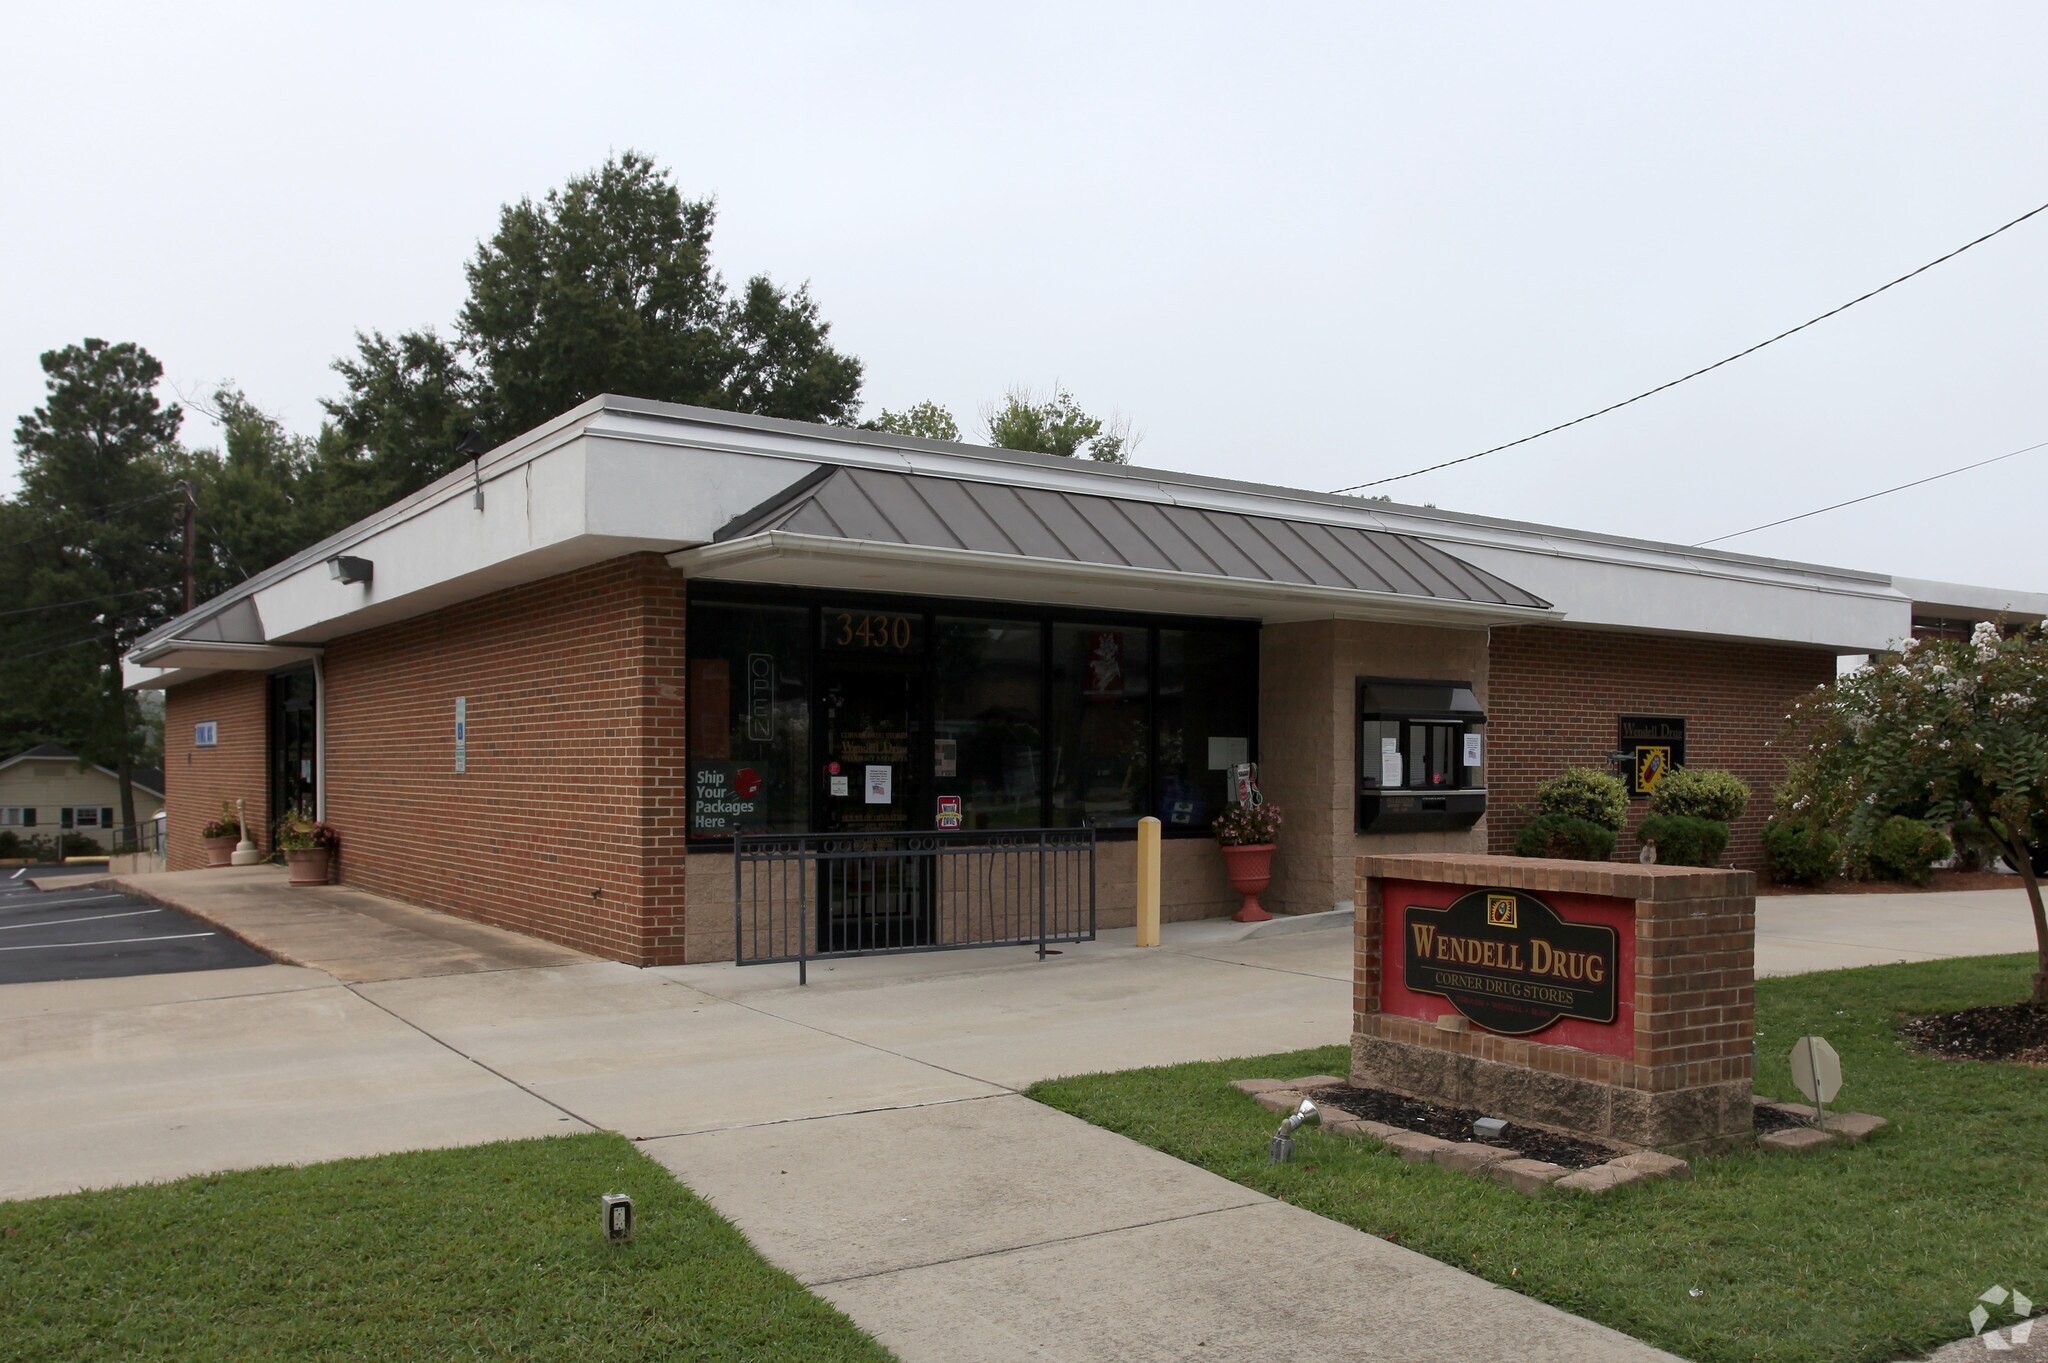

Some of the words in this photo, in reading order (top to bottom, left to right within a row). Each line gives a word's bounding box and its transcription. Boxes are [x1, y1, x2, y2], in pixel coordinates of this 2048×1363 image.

[837, 612, 911, 649] 3430
[751, 658, 770, 736] OPEN
[1623, 722, 1658, 737] Wendell
[1660, 723, 1683, 739] Drug
[697, 771, 724, 788] Ship
[696, 786, 727, 799] Your
[695, 800, 754, 816] Packages
[695, 815, 726, 829] Here
[1411, 923, 1524, 972] WENDELL
[1530, 939, 1605, 983] DRUG
[1435, 971, 1483, 991] CORNER
[1486, 980, 1521, 997] DRUG
[1524, 986, 1574, 1004] STORES
